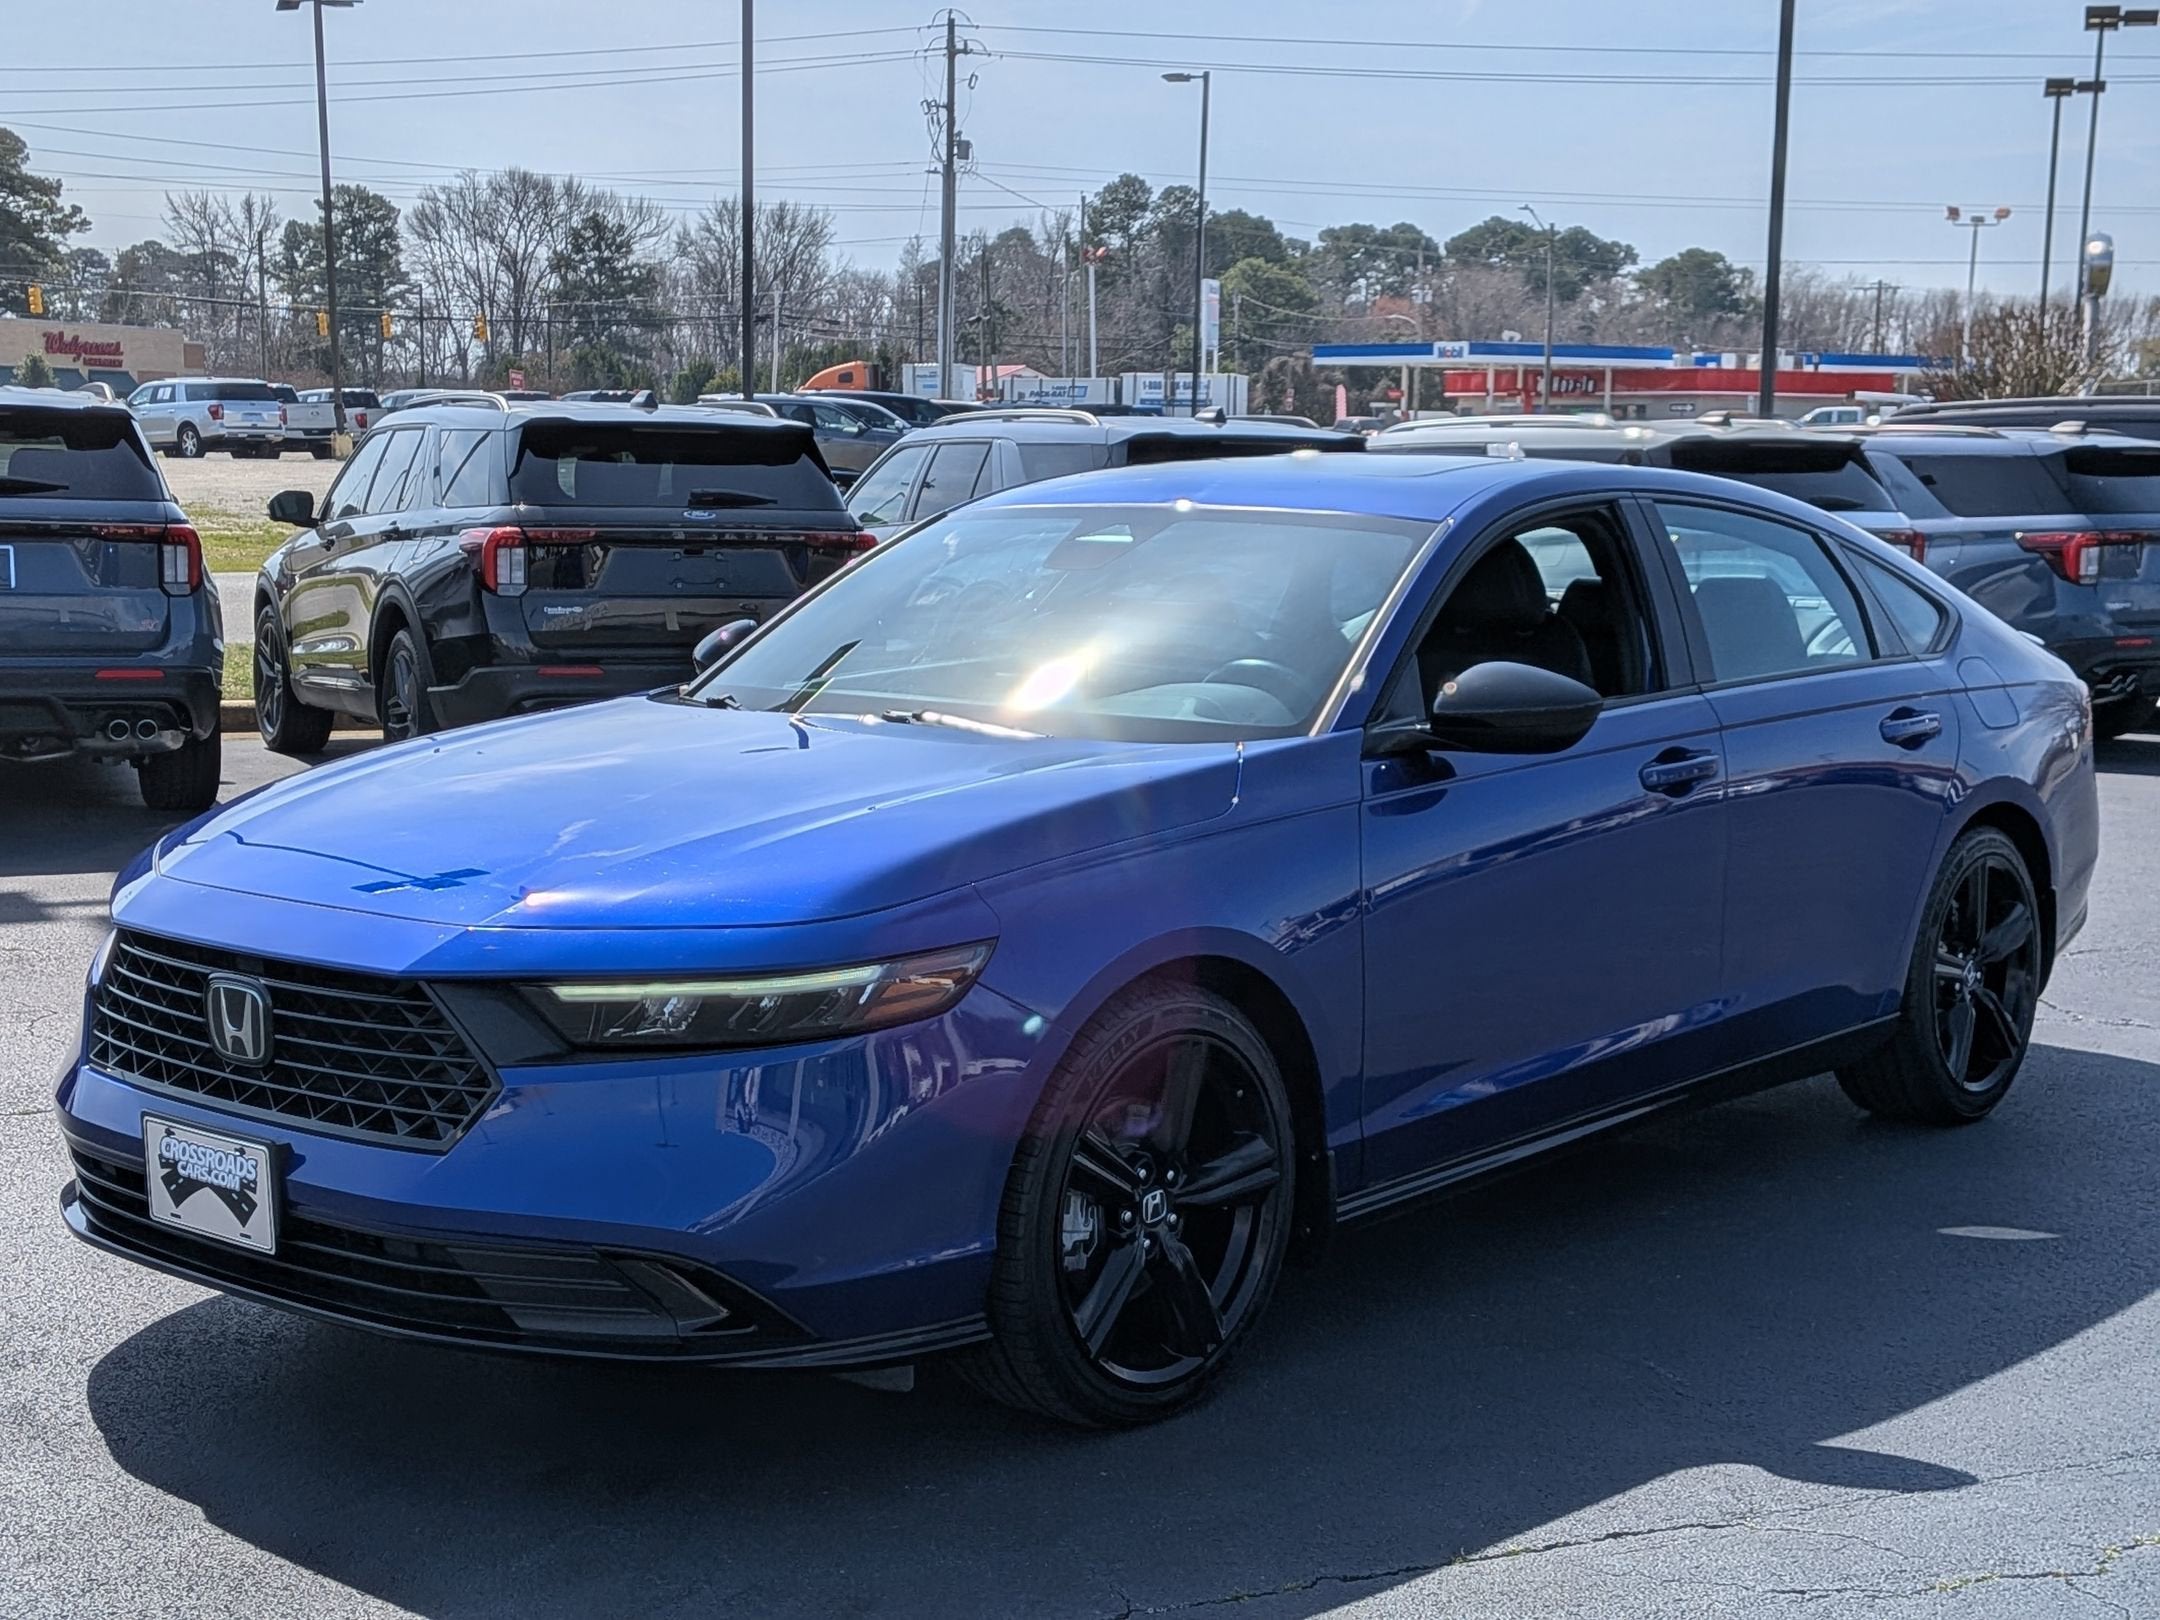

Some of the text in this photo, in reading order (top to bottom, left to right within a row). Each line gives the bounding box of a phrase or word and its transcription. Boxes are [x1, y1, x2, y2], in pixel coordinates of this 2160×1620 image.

[42, 331, 124, 363] Walgreens
[1438, 345, 1464, 359] Mobil
[1088, 1024, 1141, 1087] KELLY
[160, 1136, 257, 1181] CROSSROADS
[177, 1161, 241, 1192] CARS.COM
